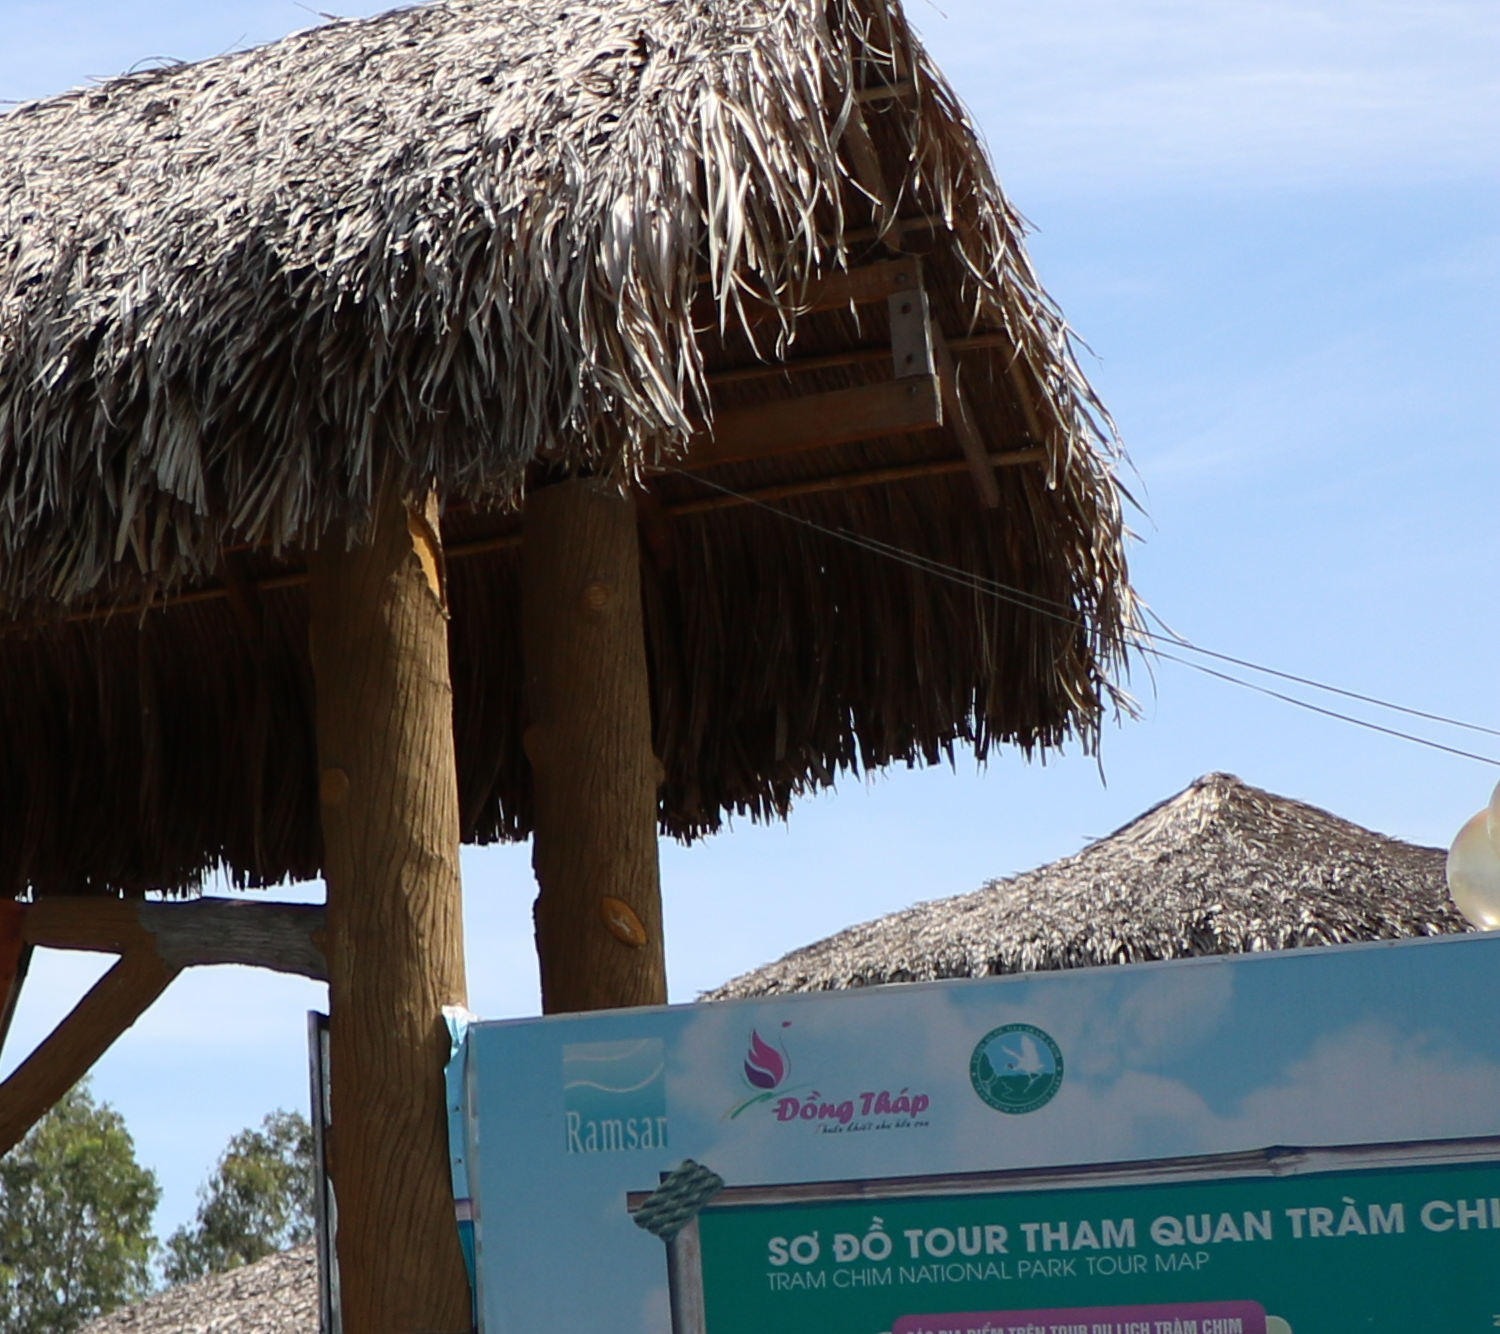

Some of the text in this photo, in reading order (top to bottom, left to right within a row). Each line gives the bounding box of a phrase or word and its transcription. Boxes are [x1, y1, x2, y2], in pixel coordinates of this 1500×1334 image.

[772, 1087, 930, 1125] Đồng Tháp
[566, 1110, 667, 1153] Ramsar
[768, 1230, 819, 1265] SƠ
[832, 1215, 892, 1261] ĐỒ
[903, 1224, 1008, 1257] TOUR
[1019, 1217, 1135, 1251] THAM
[1150, 1209, 1272, 1245] QUAN
[1285, 1196, 1404, 1238] TRÀM
[766, 1251, 1209, 1290] TRAM CHIM NATIONAL PARK TOUR MAP
[1201, 1317, 1242, 1334] CHIM
